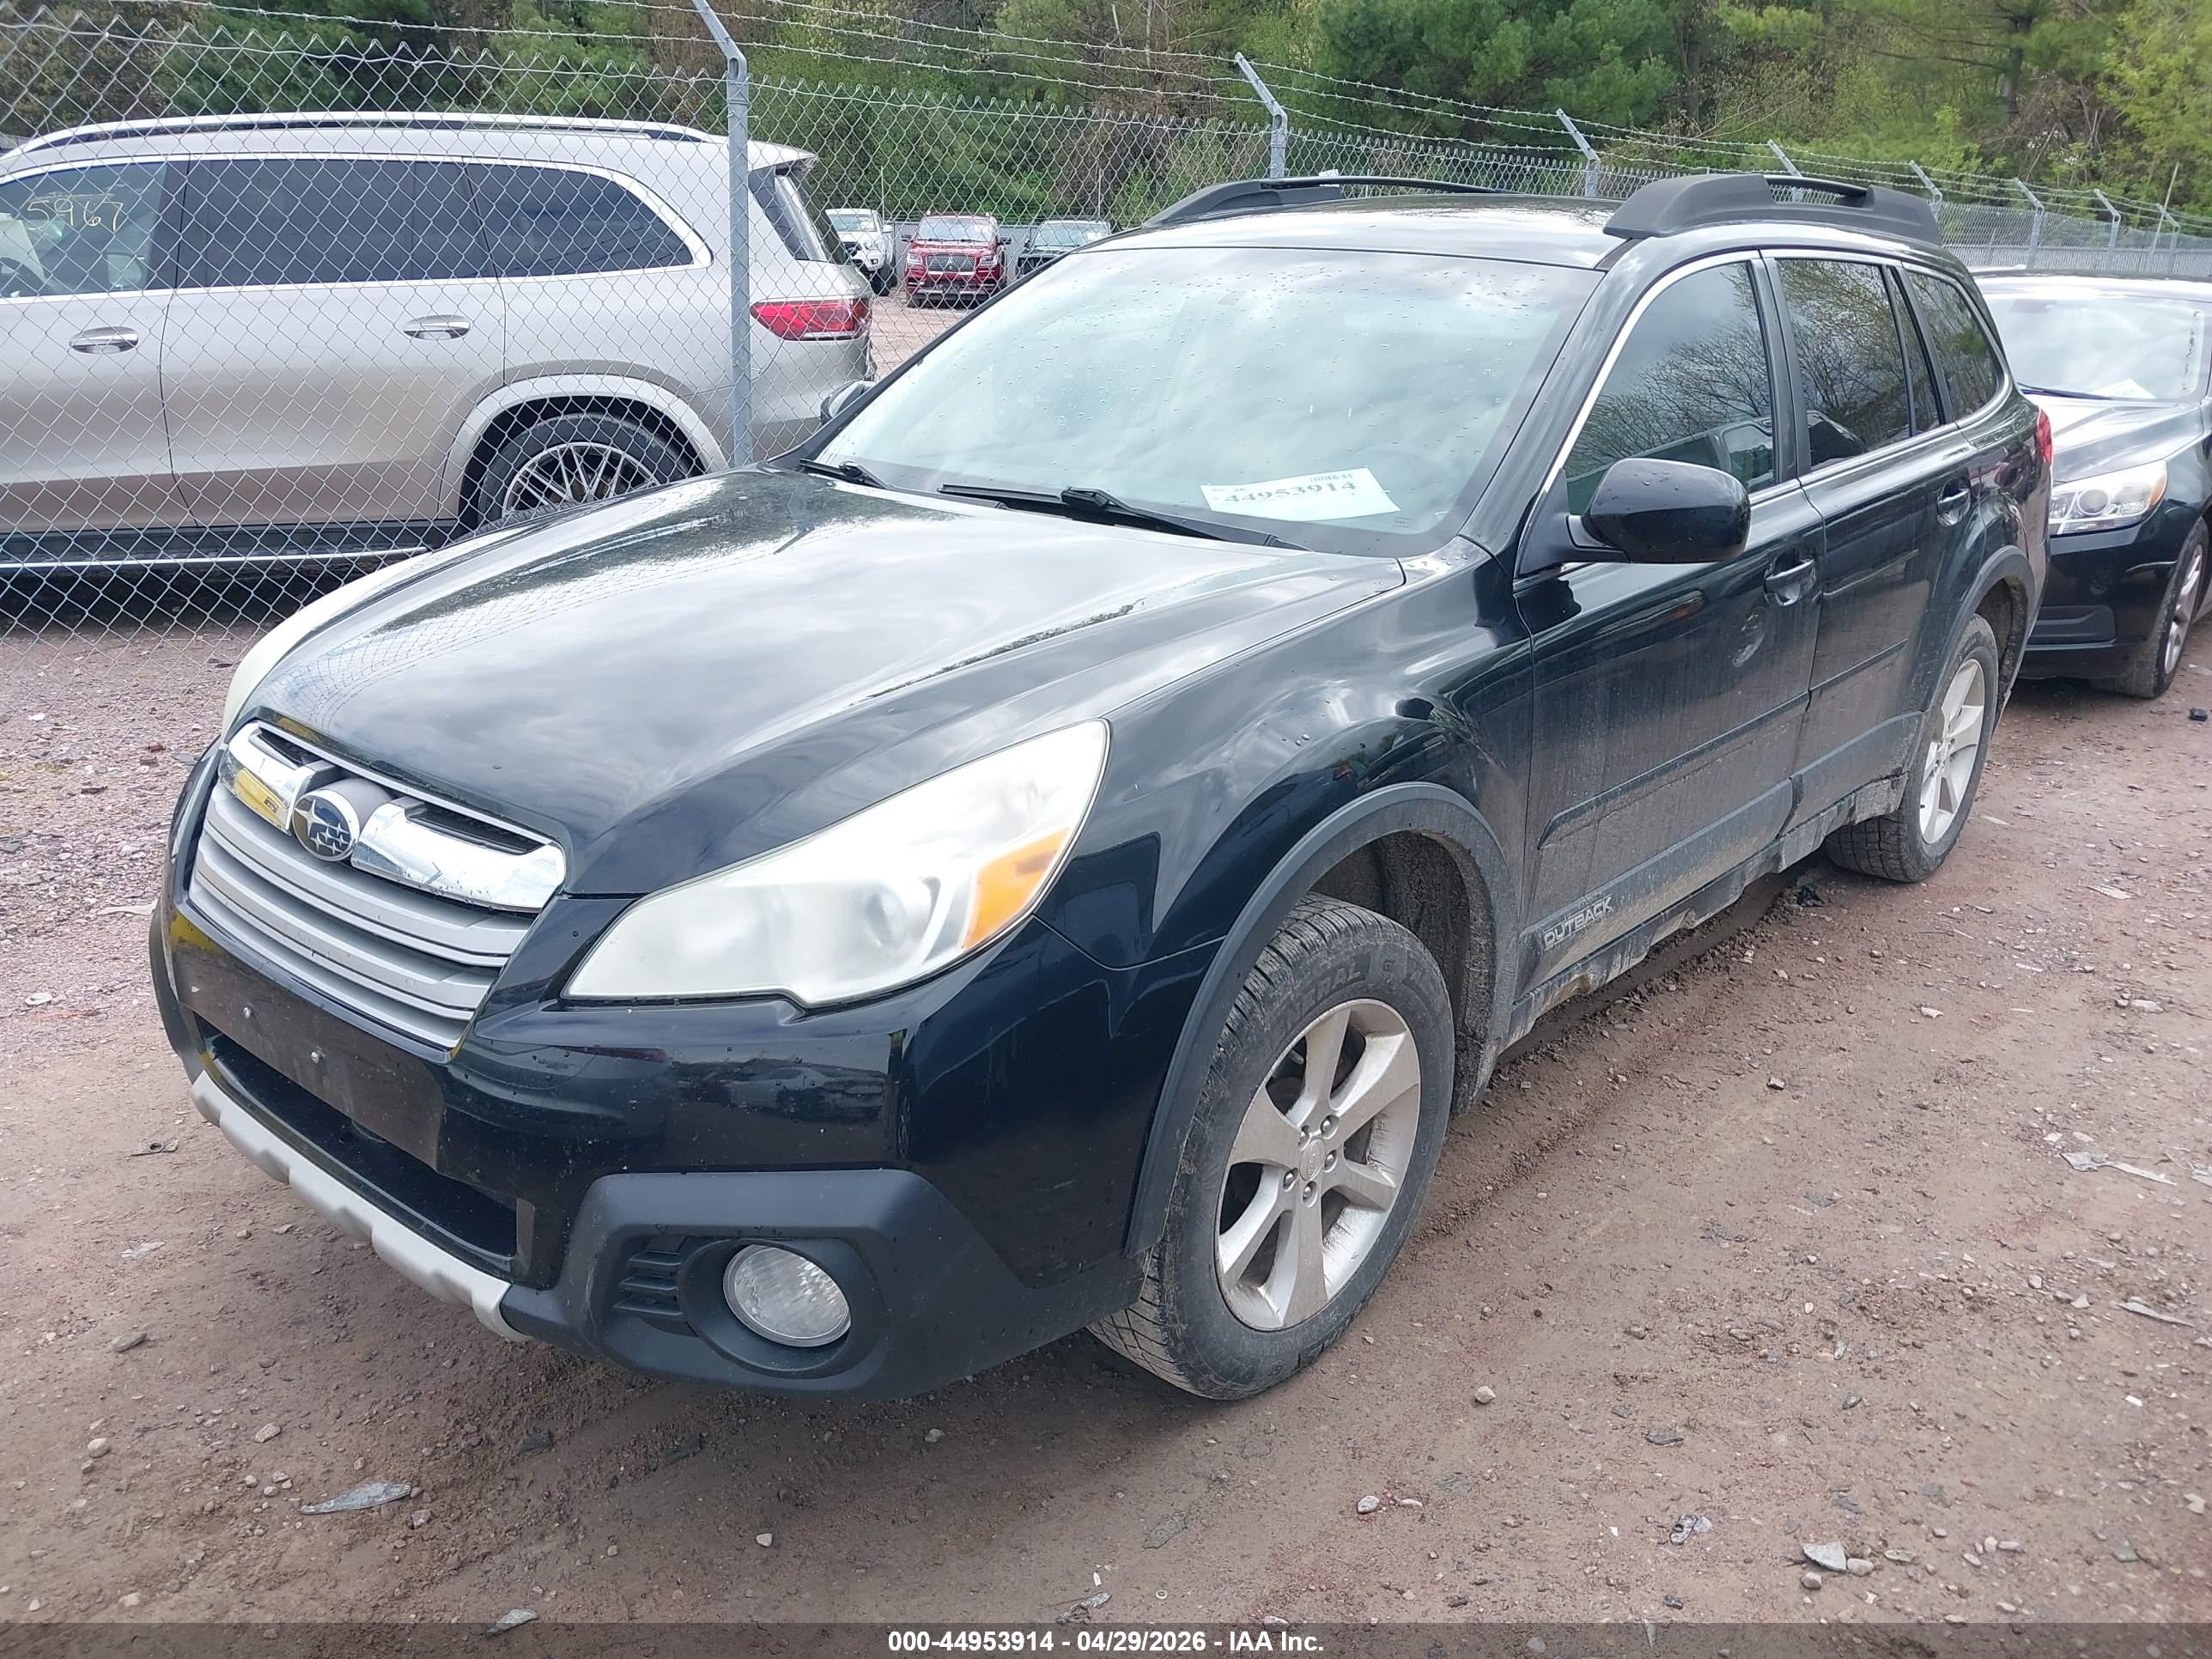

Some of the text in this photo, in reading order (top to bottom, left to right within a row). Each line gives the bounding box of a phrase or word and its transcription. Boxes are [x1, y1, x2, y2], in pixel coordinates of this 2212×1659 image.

[27, 198, 124, 233] 5967
[1224, 481, 1358, 503] 44953914
[1544, 896, 1613, 947] OUTBACK
